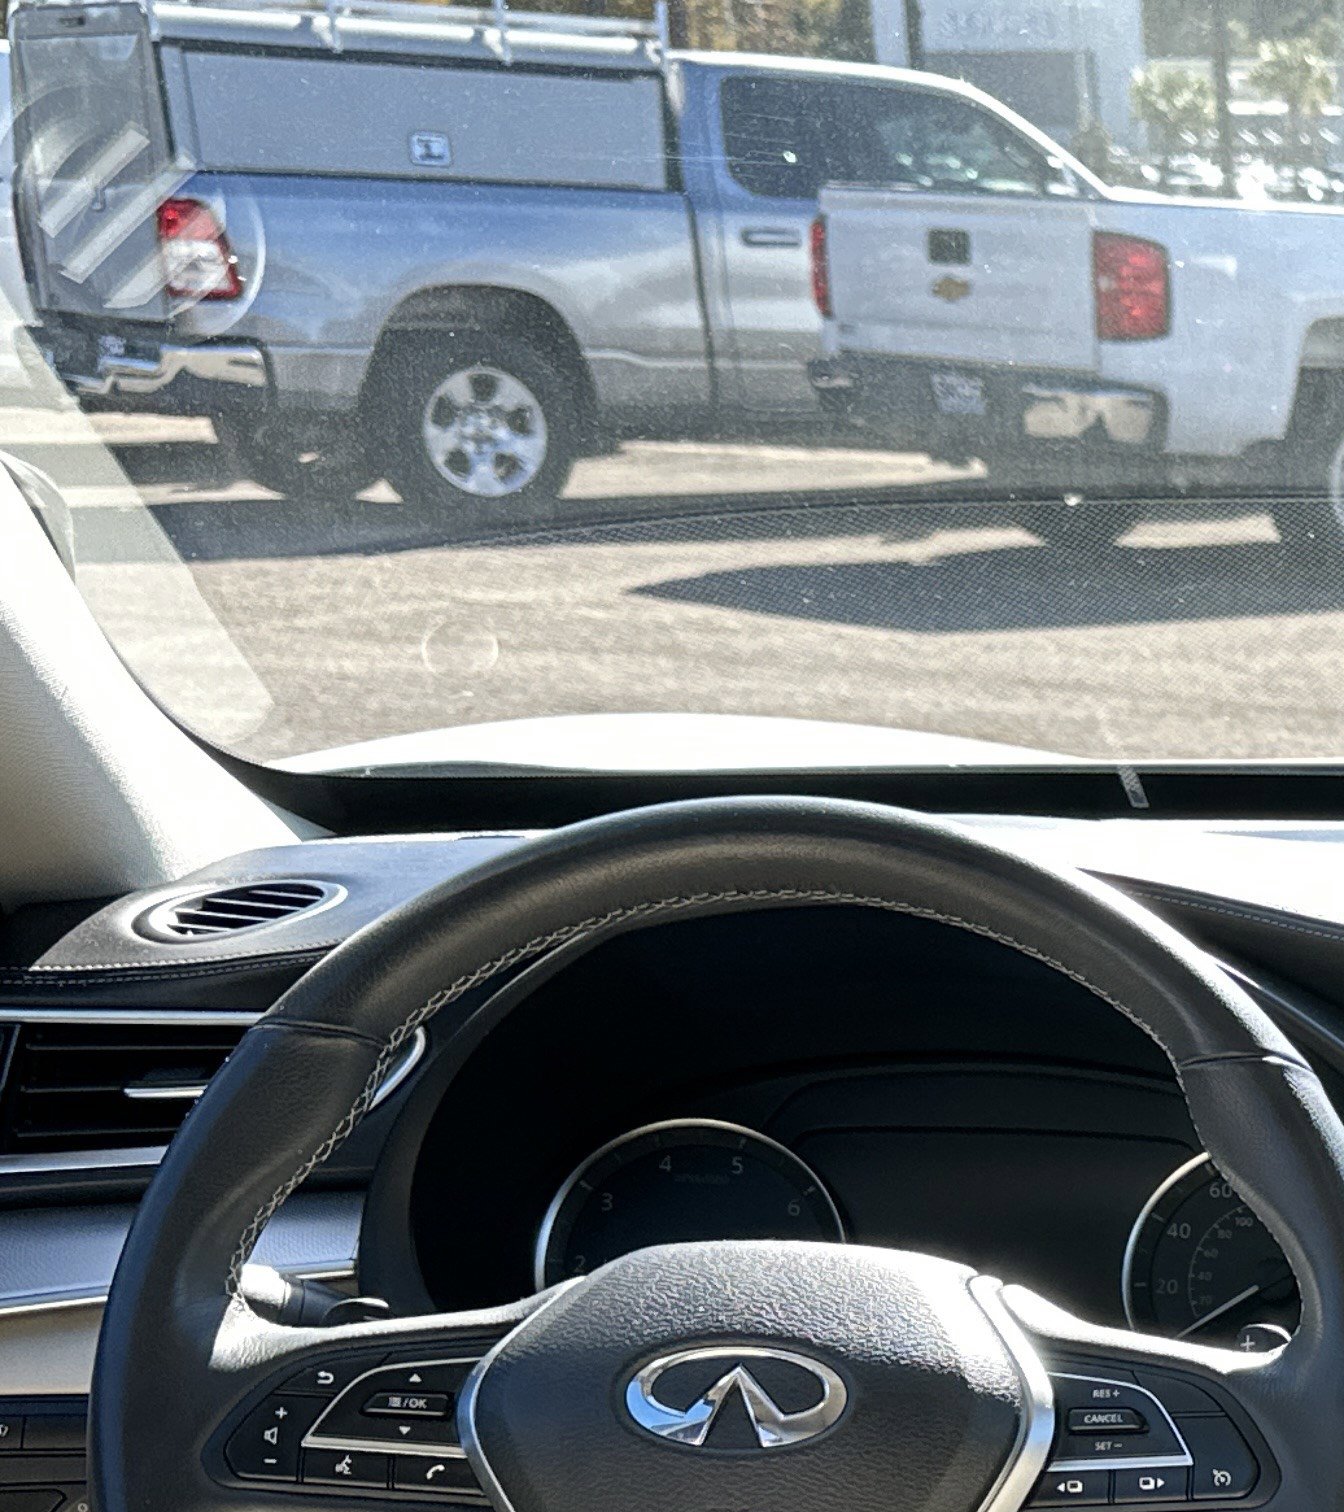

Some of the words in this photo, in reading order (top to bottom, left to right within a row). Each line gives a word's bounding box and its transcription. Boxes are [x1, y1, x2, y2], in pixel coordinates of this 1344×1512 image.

[659, 1155, 672, 1173] 4
[731, 1156, 743, 1175] 5
[601, 1192, 614, 1212] 3
[787, 1198, 801, 1217] 6
[1166, 1221, 1192, 1239] 40
[1156, 1278, 1178, 1294] 20
[1083, 1413, 1123, 1425] CANCEL
